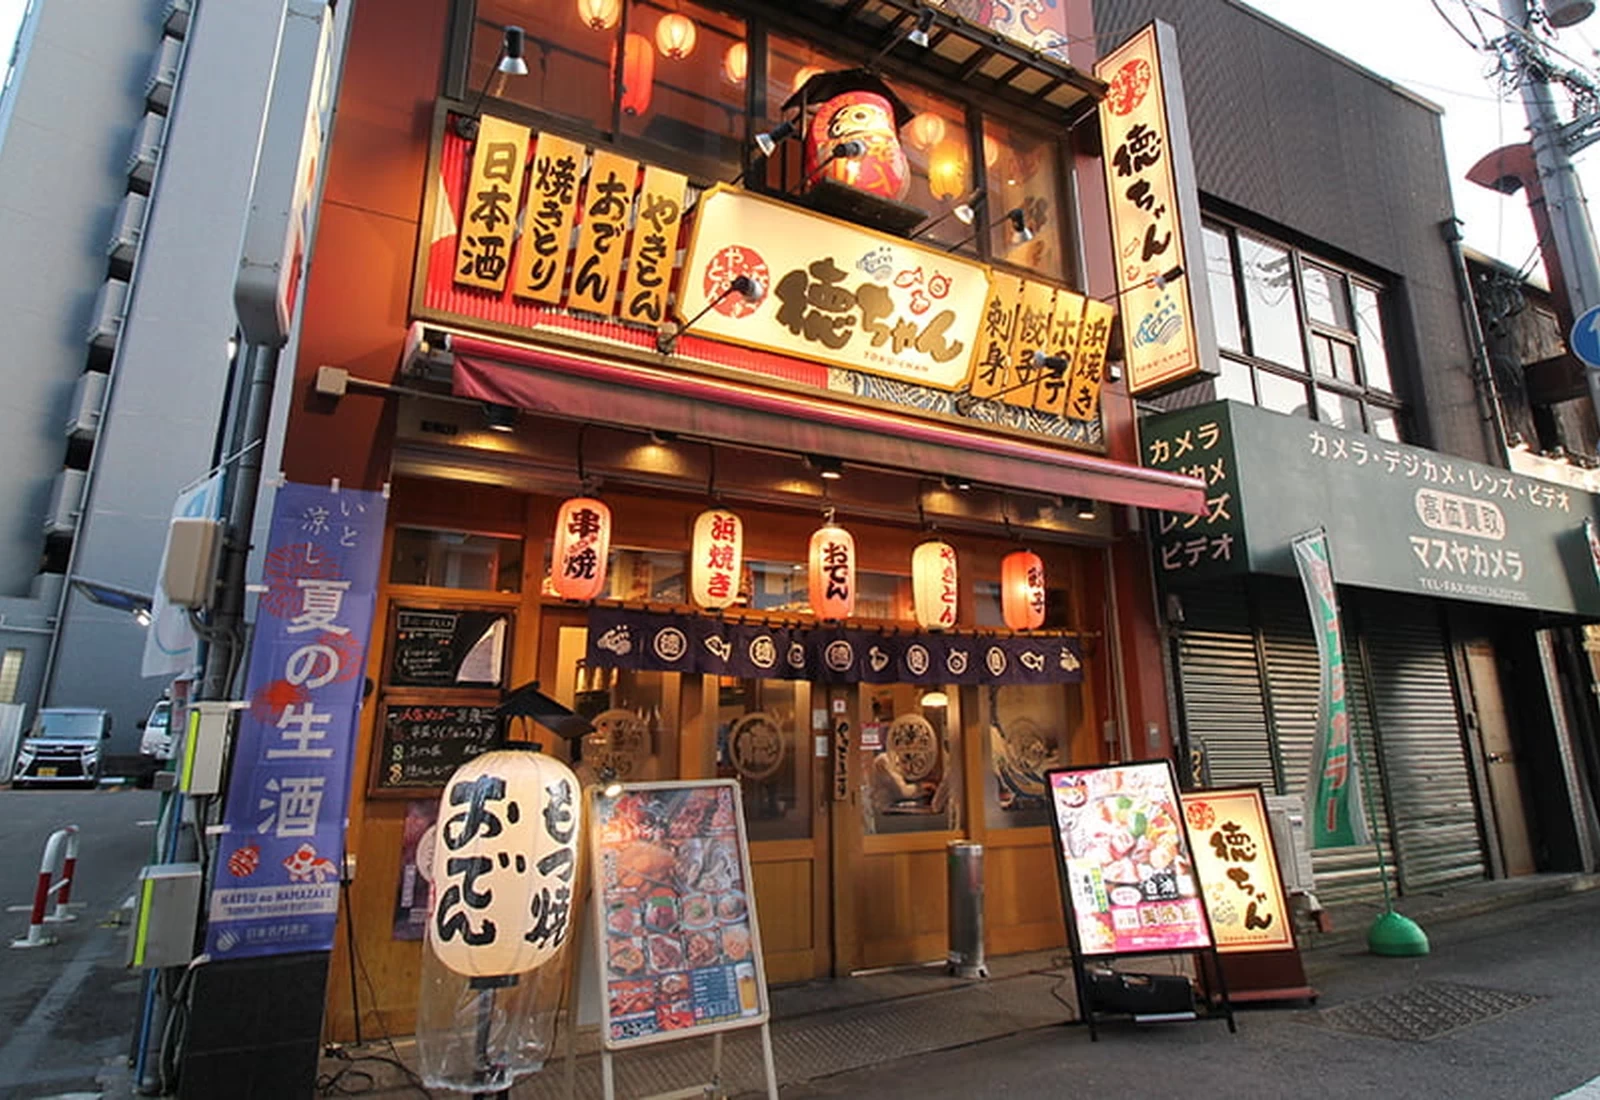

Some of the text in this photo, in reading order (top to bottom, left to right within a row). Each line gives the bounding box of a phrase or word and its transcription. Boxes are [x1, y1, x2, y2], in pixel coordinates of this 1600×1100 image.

[460, 142, 517, 281] 日本酒
[527, 156, 577, 291] 焼きとり
[574, 171, 630, 303] おでん
[628, 192, 679, 322] やきとん
[979, 295, 1013, 386] 刺身
[1015, 305, 1046, 385] 餃子
[1073, 317, 1107, 416] 浜焼き
[1149, 421, 1220, 465] カメラ
[302, 506, 330, 565] 涼し
[341, 500, 365, 548] いと
[708, 514, 736, 599] 浜焼き
[1409, 536, 1523, 581] マスヤカメラ
[823, 542, 848, 601] おでん
[257, 579, 352, 840] 夏の生酒
[436, 774, 526, 946] おでん
